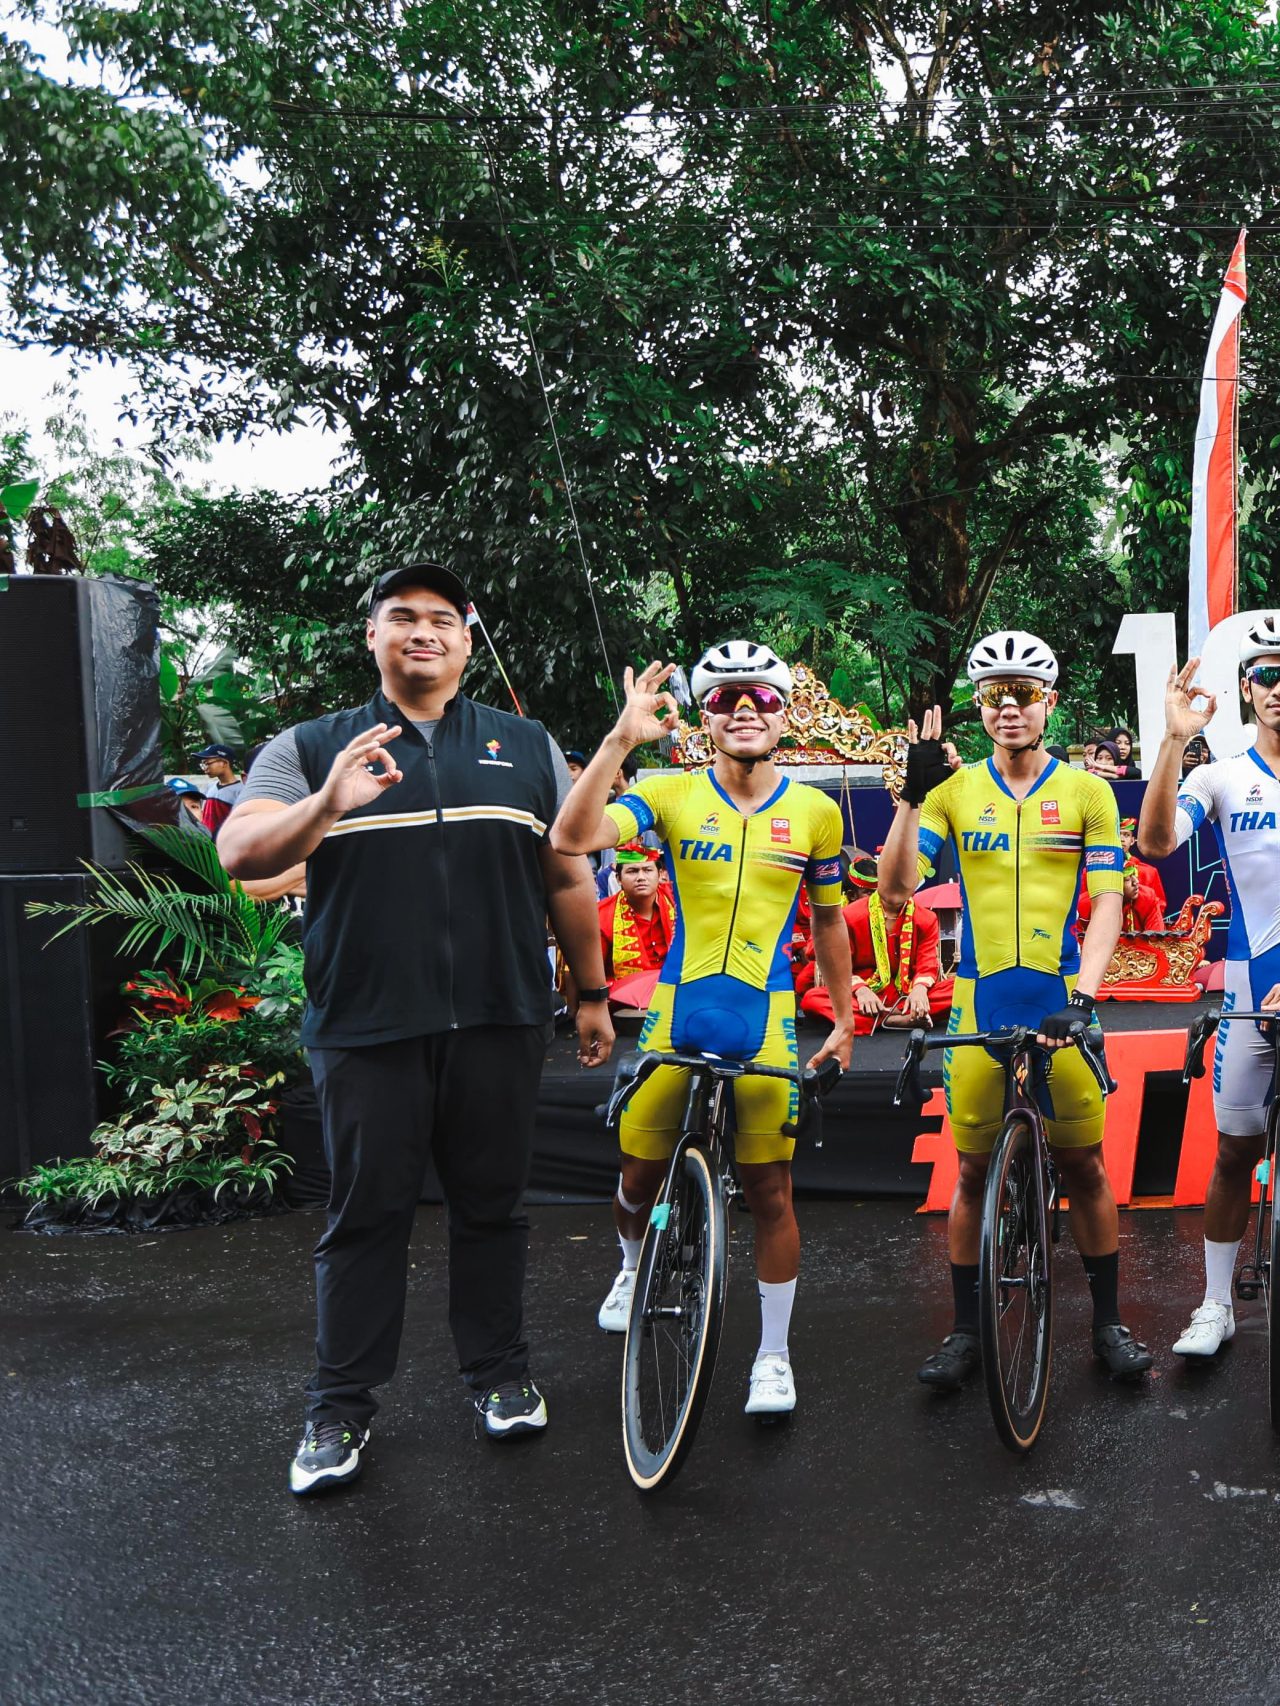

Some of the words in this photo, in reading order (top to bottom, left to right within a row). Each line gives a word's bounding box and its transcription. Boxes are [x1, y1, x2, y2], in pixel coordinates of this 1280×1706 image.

[1230, 811, 1277, 833] THA
[679, 839, 734, 862] THA
[961, 831, 1010, 852] THA
